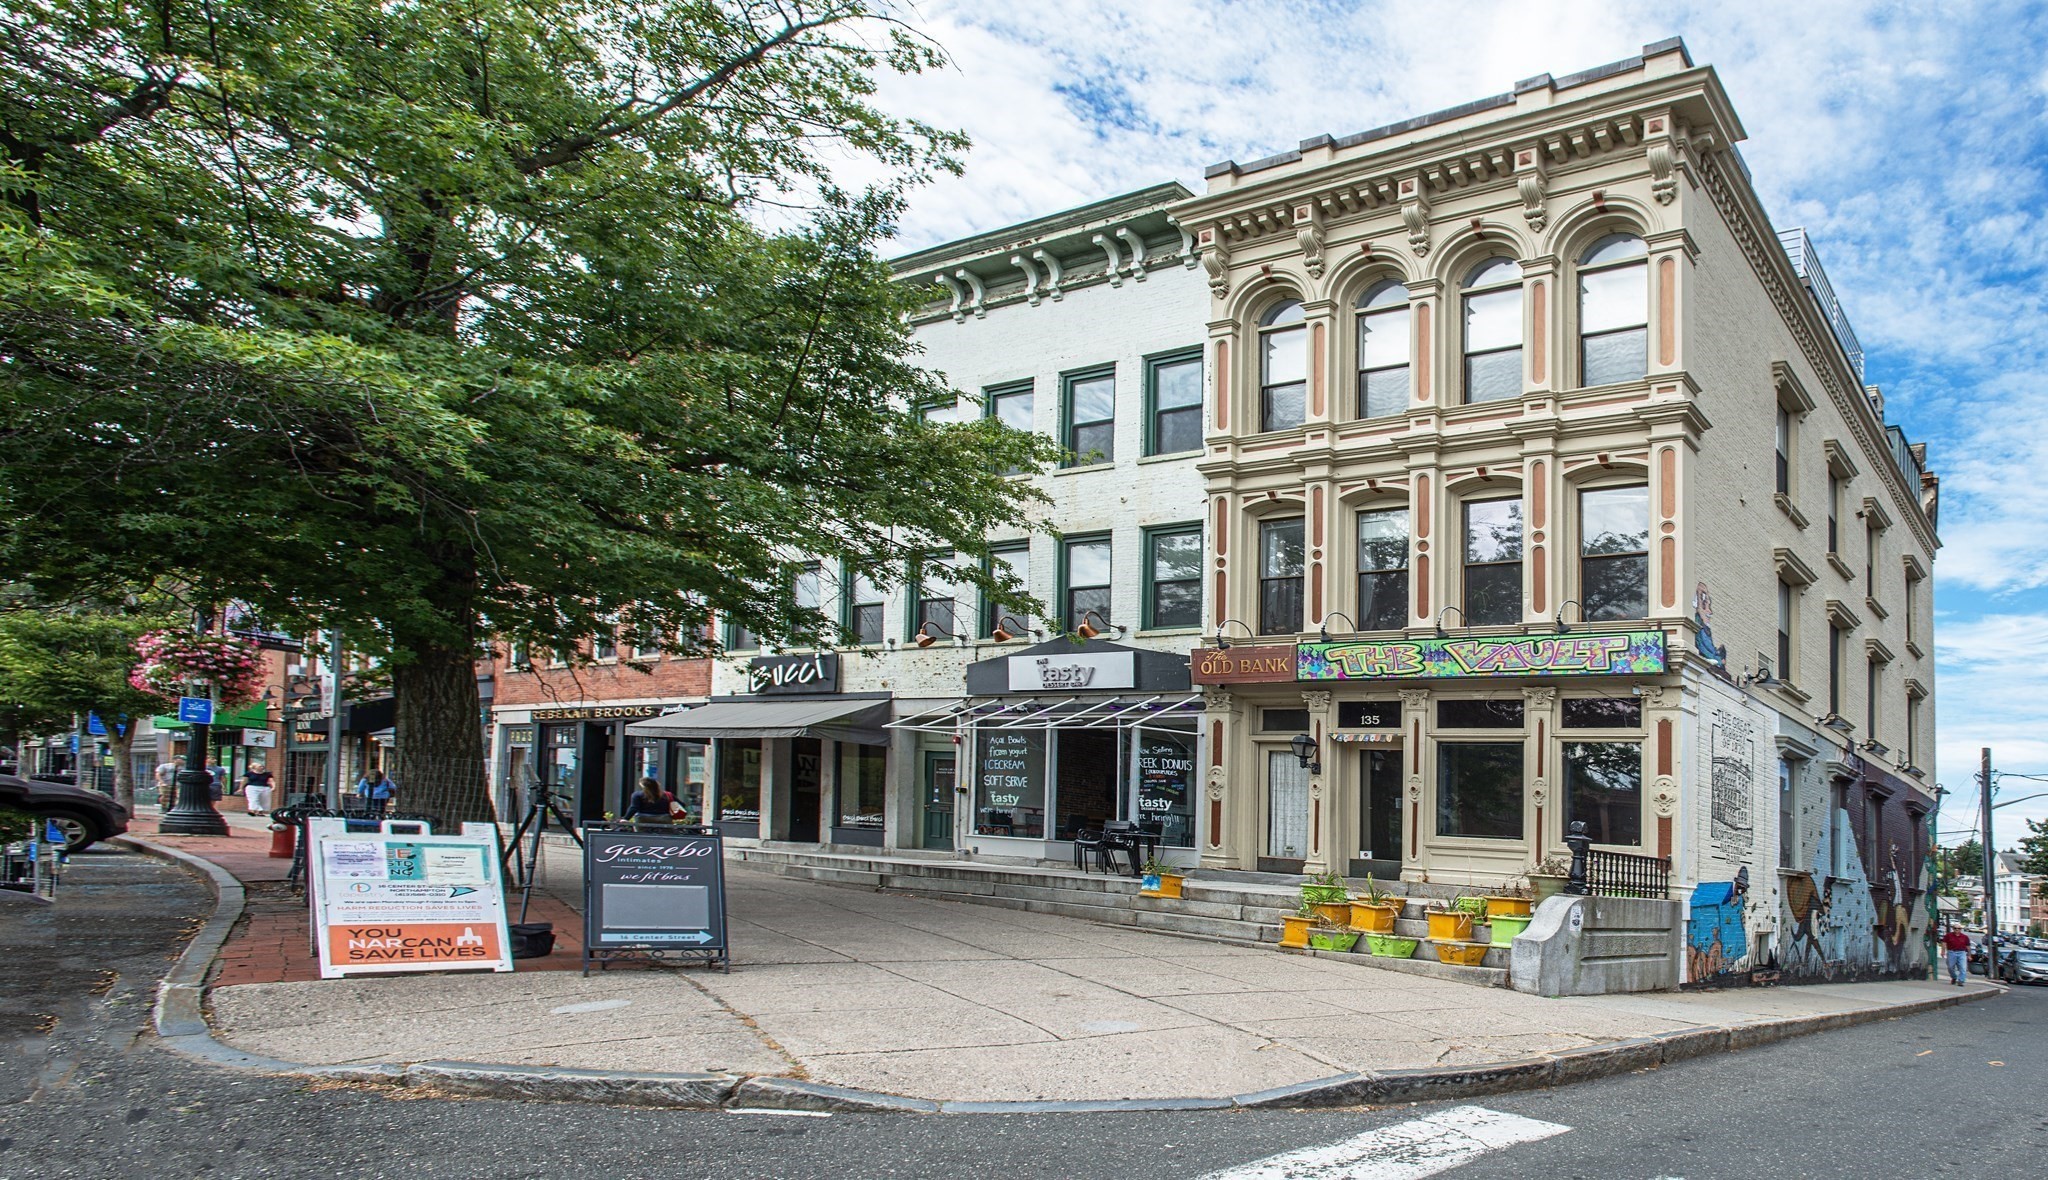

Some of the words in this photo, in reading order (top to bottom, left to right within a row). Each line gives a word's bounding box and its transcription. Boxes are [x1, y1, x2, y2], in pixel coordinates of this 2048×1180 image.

[1204, 651, 1228, 662] The
[1324, 642, 1425, 677] THE
[1442, 635, 1629, 673] VAULT
[1201, 661, 1234, 675] OLD
[1240, 657, 1289, 674] BANK
[1038, 664, 1096, 687] tasty
[532, 709, 590, 720] REBEKAH
[594, 706, 652, 718] BROOKS
[1361, 715, 1380, 725] 135
[1732, 717, 1751, 735] GREAT
[1007, 735, 1027, 745] Bowls
[989, 746, 1007, 757] frozen
[1008, 747, 1028, 758] yogurt
[1152, 746, 1173, 756] Selling
[1138, 757, 1158, 768] REEK
[1161, 758, 1193, 771] DONUTS
[983, 775, 1004, 787] SOFT
[1005, 775, 1028, 788] SERVE
[991, 793, 1020, 806] tasty
[1139, 797, 1172, 811] tasty
[596, 841, 713, 862] gazebo
[638, 872, 663, 882] fit
[661, 872, 691, 880] bras
[348, 928, 402, 938] YOU
[349, 937, 452, 949] NARCAN
[349, 948, 415, 960] SAVE
[421, 946, 486, 958] LIVES
